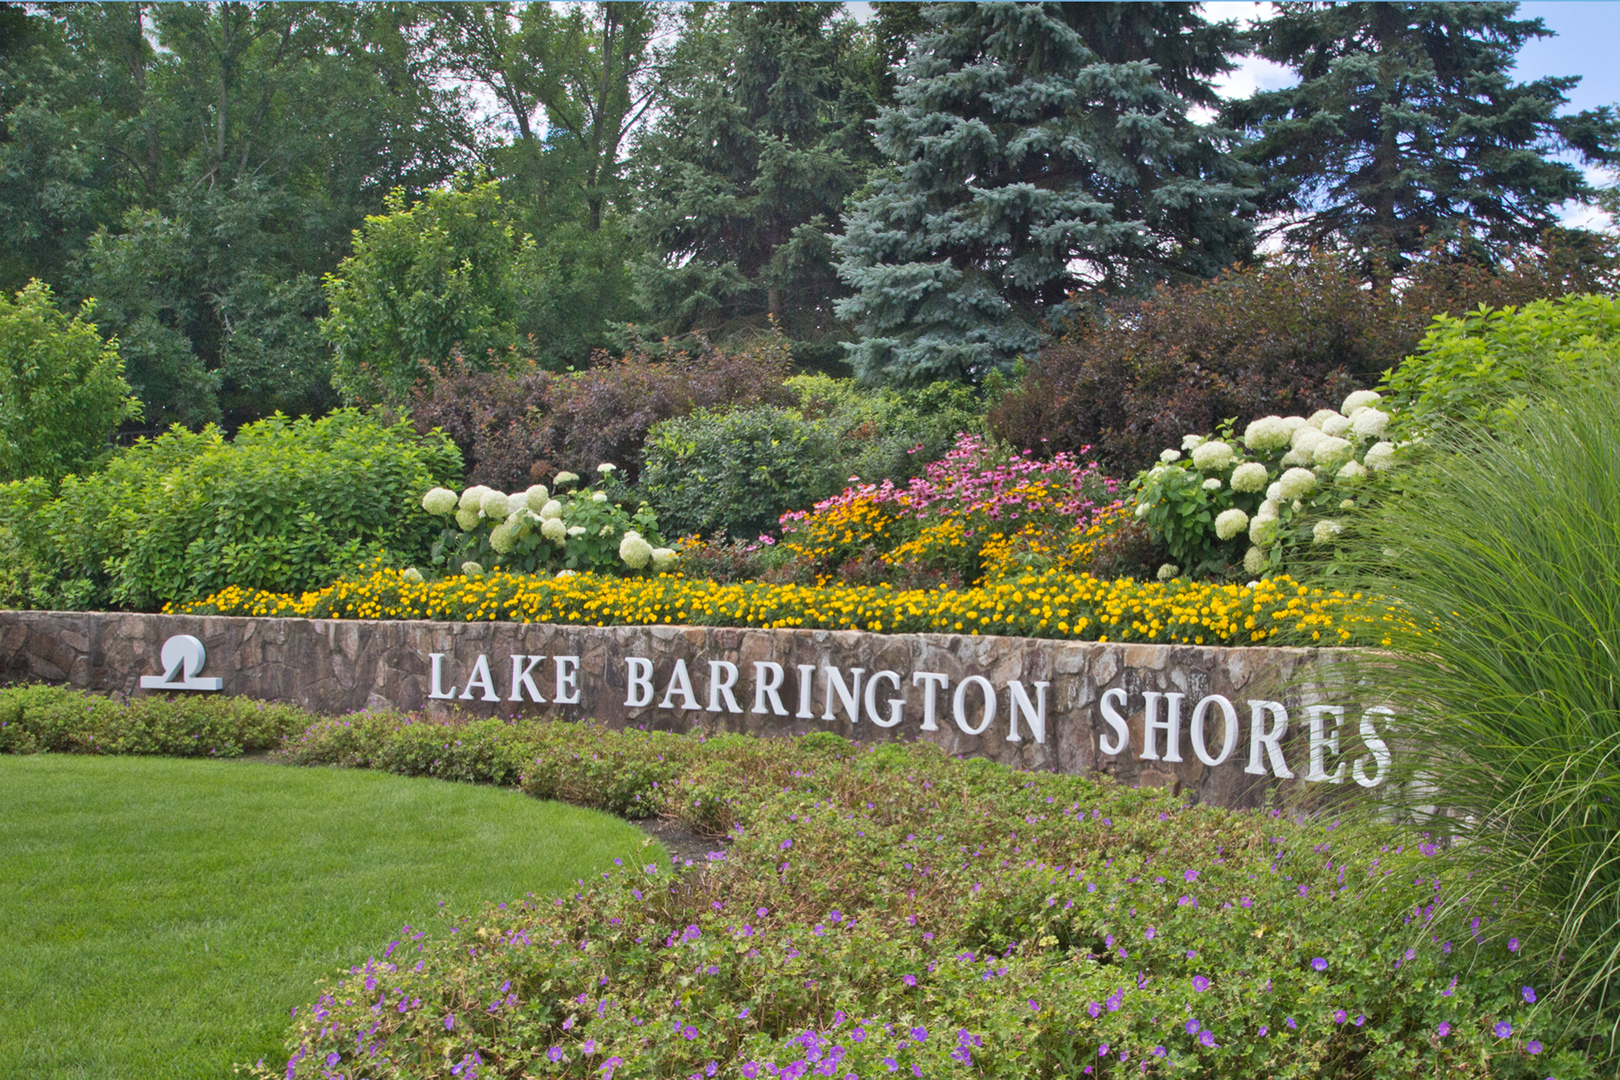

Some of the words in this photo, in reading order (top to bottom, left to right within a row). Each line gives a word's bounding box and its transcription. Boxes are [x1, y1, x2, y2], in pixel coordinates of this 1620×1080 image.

[428, 652, 581, 705] LAKE
[623, 656, 1051, 745] BARRINGTON
[1099, 687, 1396, 788] SHORES
